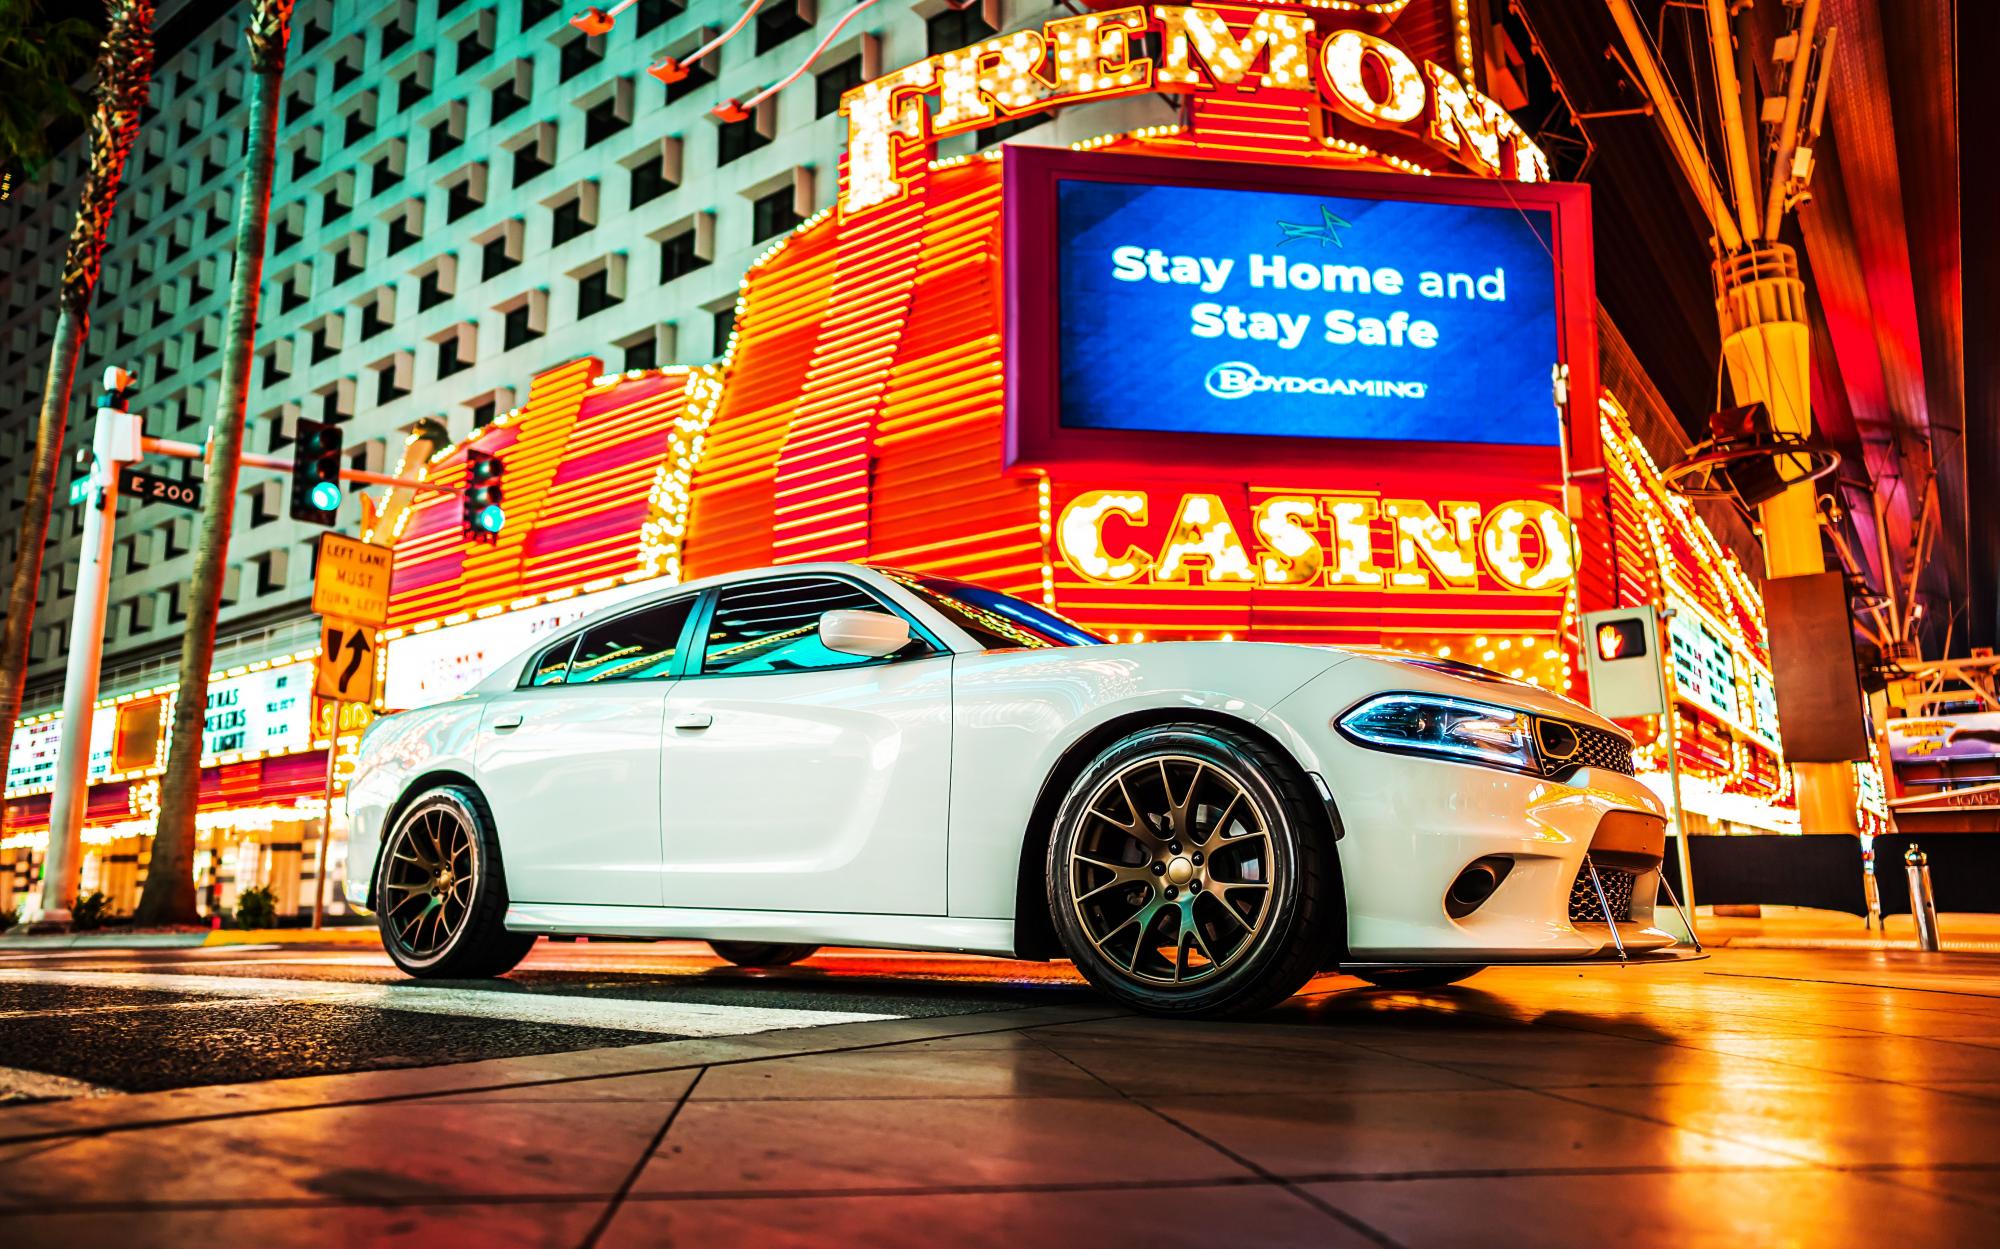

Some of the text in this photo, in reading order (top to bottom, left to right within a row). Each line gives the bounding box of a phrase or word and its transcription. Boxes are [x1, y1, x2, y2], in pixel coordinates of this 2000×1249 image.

[837, 4, 1550, 226] FREMONT
[1111, 244, 1507, 302] Stay Home and
[1190, 302, 1440, 349] Stay Safe
[131, 476, 195, 504] E 200
[1056, 490, 1582, 592] CASINO
[327, 543, 386, 568] LEFT LANE
[336, 568, 374, 589] MUST
[321, 588, 383, 613] TURN LEFT
[1947, 792, 1999, 806] CIGARS
